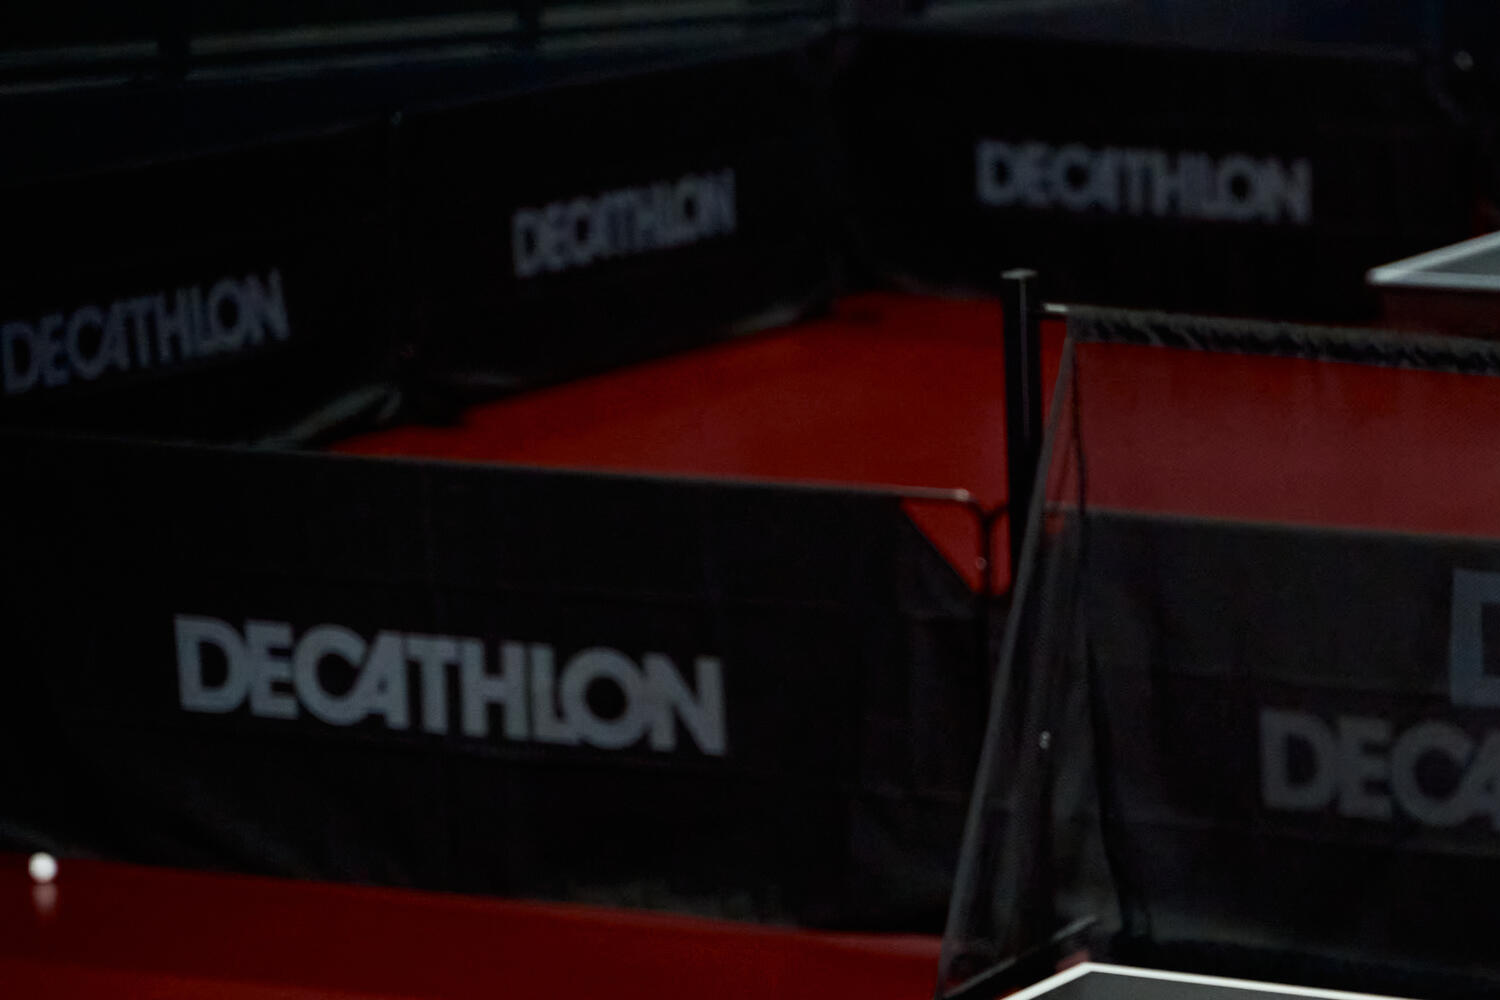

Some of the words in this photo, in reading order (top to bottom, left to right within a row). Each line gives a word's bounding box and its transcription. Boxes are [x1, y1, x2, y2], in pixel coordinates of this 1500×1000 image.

[511, 168, 737, 280] DECATHLON
[974, 138, 1312, 226] DECATHLON
[0, 266, 290, 396] DECATHLON
[173, 612, 728, 758] DECATHLON
